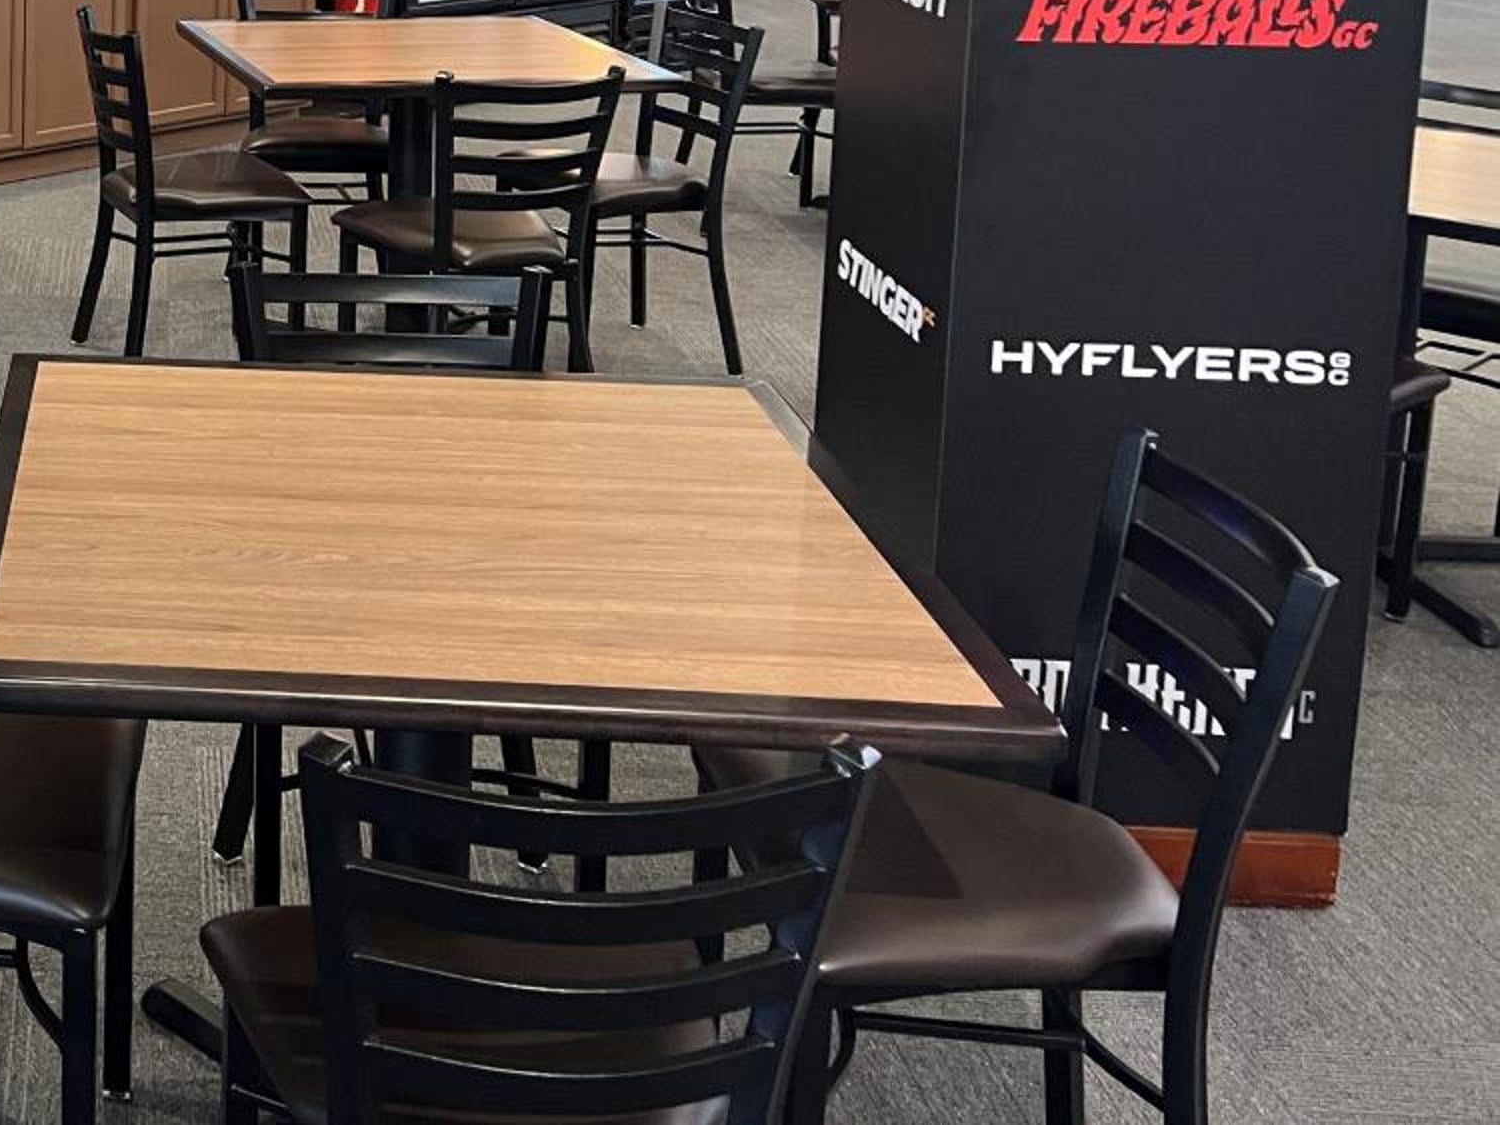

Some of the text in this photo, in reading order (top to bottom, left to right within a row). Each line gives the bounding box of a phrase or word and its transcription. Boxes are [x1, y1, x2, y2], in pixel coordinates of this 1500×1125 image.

[1331, 20, 1380, 50] GC
[837, 238, 924, 344] STINGER
[990, 339, 1325, 386] HYFLYERS
